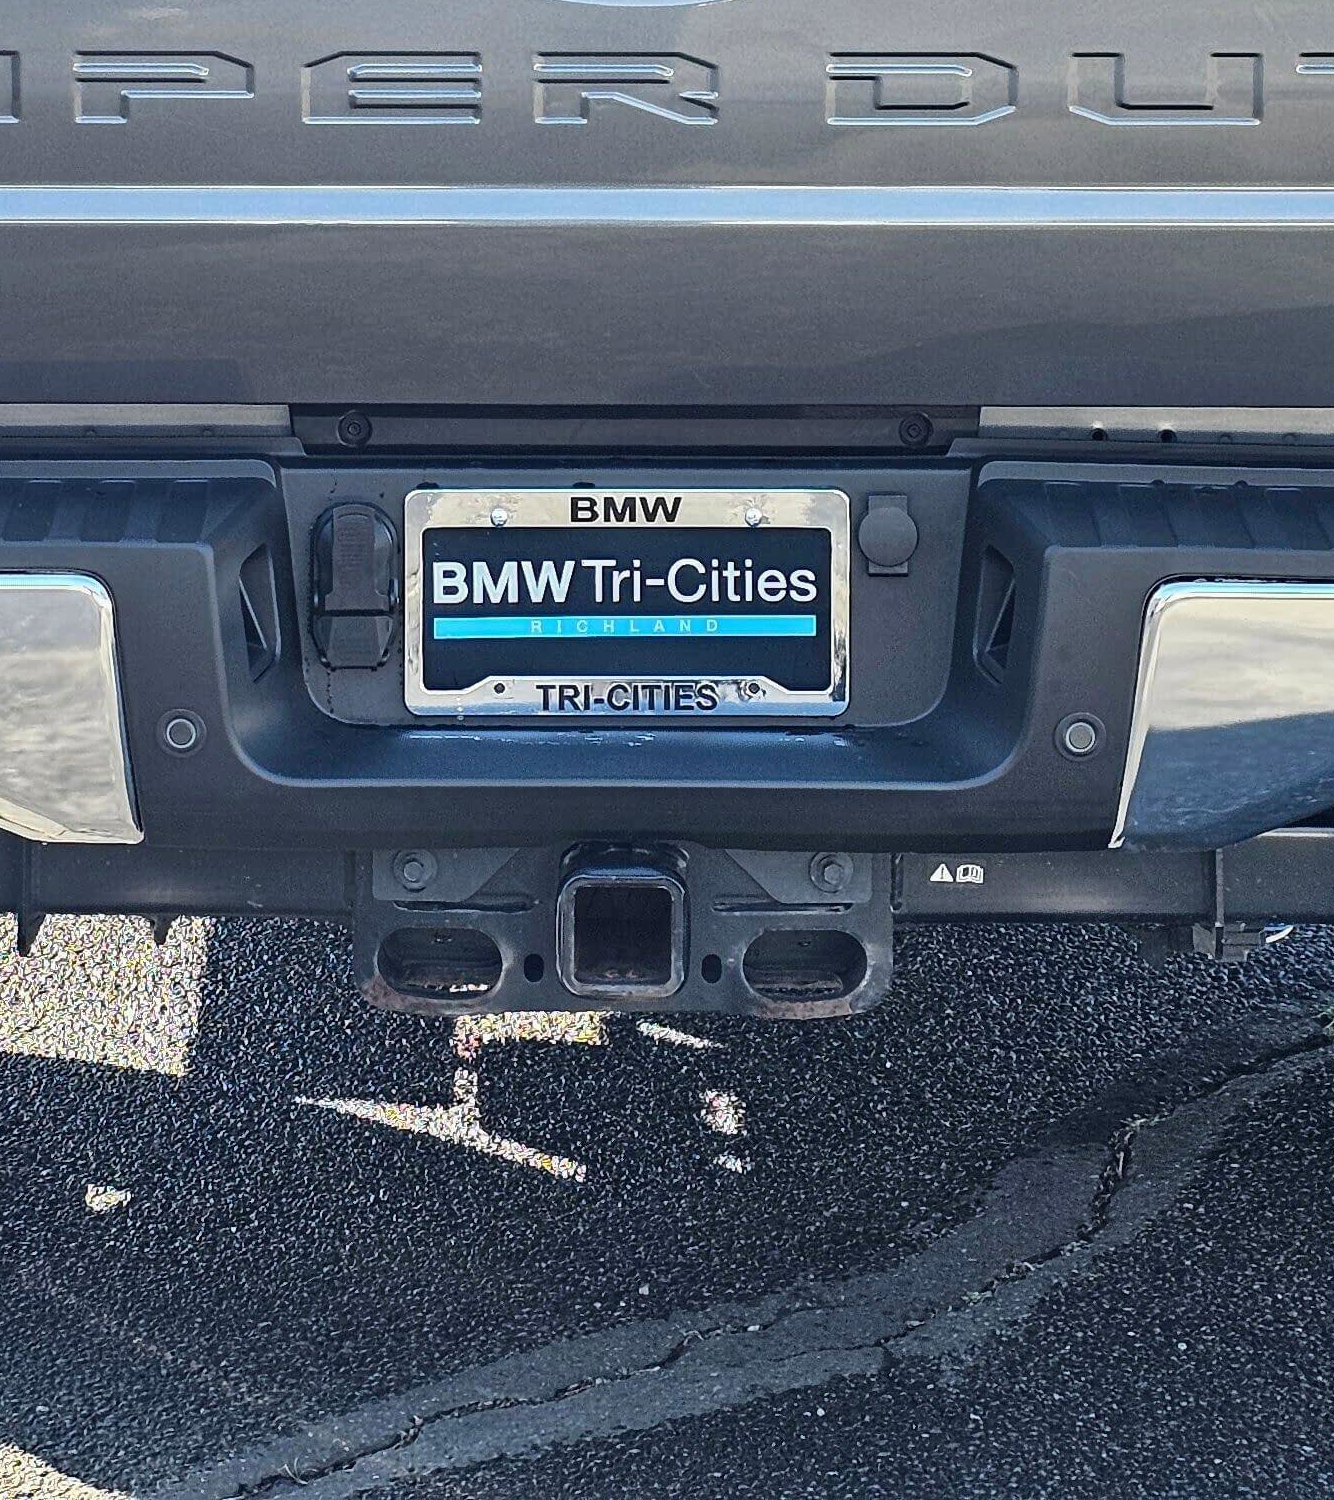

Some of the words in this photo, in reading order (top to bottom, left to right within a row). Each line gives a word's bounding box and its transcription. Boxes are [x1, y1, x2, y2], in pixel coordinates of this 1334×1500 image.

[569, 496, 683, 523] BMW
[432, 560, 575, 605] BMW
[581, 558, 818, 604] Tri-Cities
[530, 618, 720, 634] RICHLAND
[535, 682, 720, 713] TRI-CITIES
